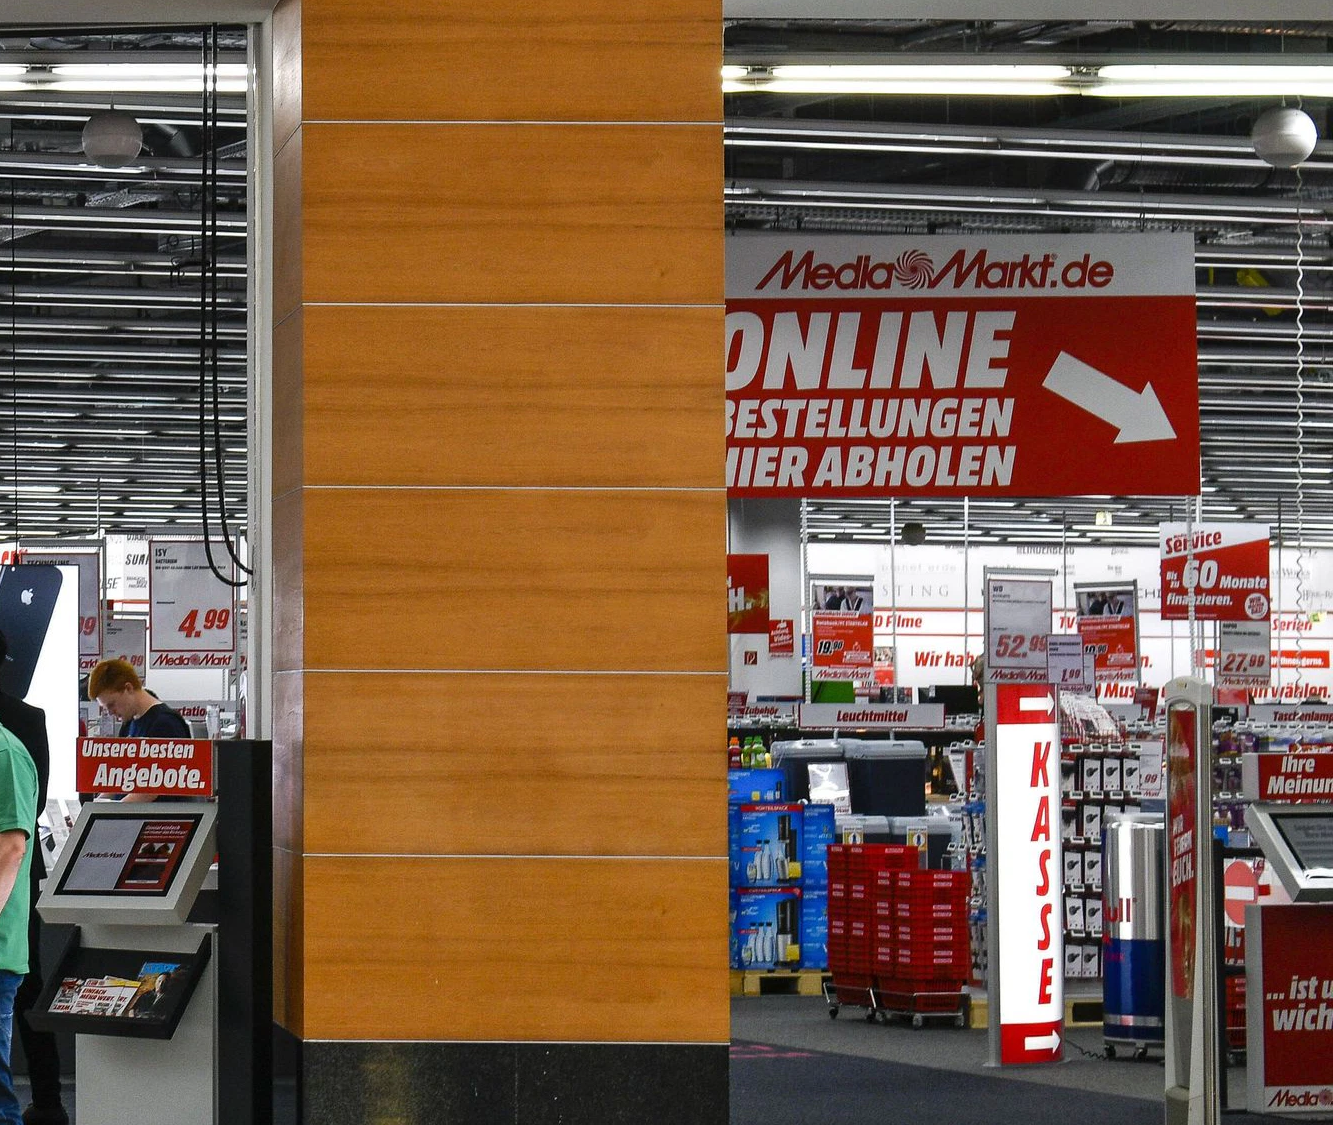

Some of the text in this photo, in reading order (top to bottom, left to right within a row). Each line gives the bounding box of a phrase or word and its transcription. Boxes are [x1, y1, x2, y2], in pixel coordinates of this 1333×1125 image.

[755, 249, 896, 290] Media
[726, 311, 1016, 390] ONLINE
[812, 445, 1017, 487] ABHOLEN
[155, 548, 168, 557] ISY
[1183, 559, 1267, 589] 60 Monate
[178, 609, 230, 638] 4.99
[1272, 618, 1312, 631] Serien
[153, 653, 232, 666] Media Markt
[915, 651, 942, 667] Wir
[837, 710, 908, 723] Leuchtmittel
[82, 740, 193, 759] Unsere besten
[1281, 755, 1315, 773] Ihre
[93, 762, 205, 791] Angebote.
[1267, 775, 1333, 795] Meinun
[1030, 742, 1054, 1004] KASSE
[1289, 976, 1318, 1000] ist
[1272, 1003, 1333, 1031] wich
[1268, 1090, 1319, 1107] Media
